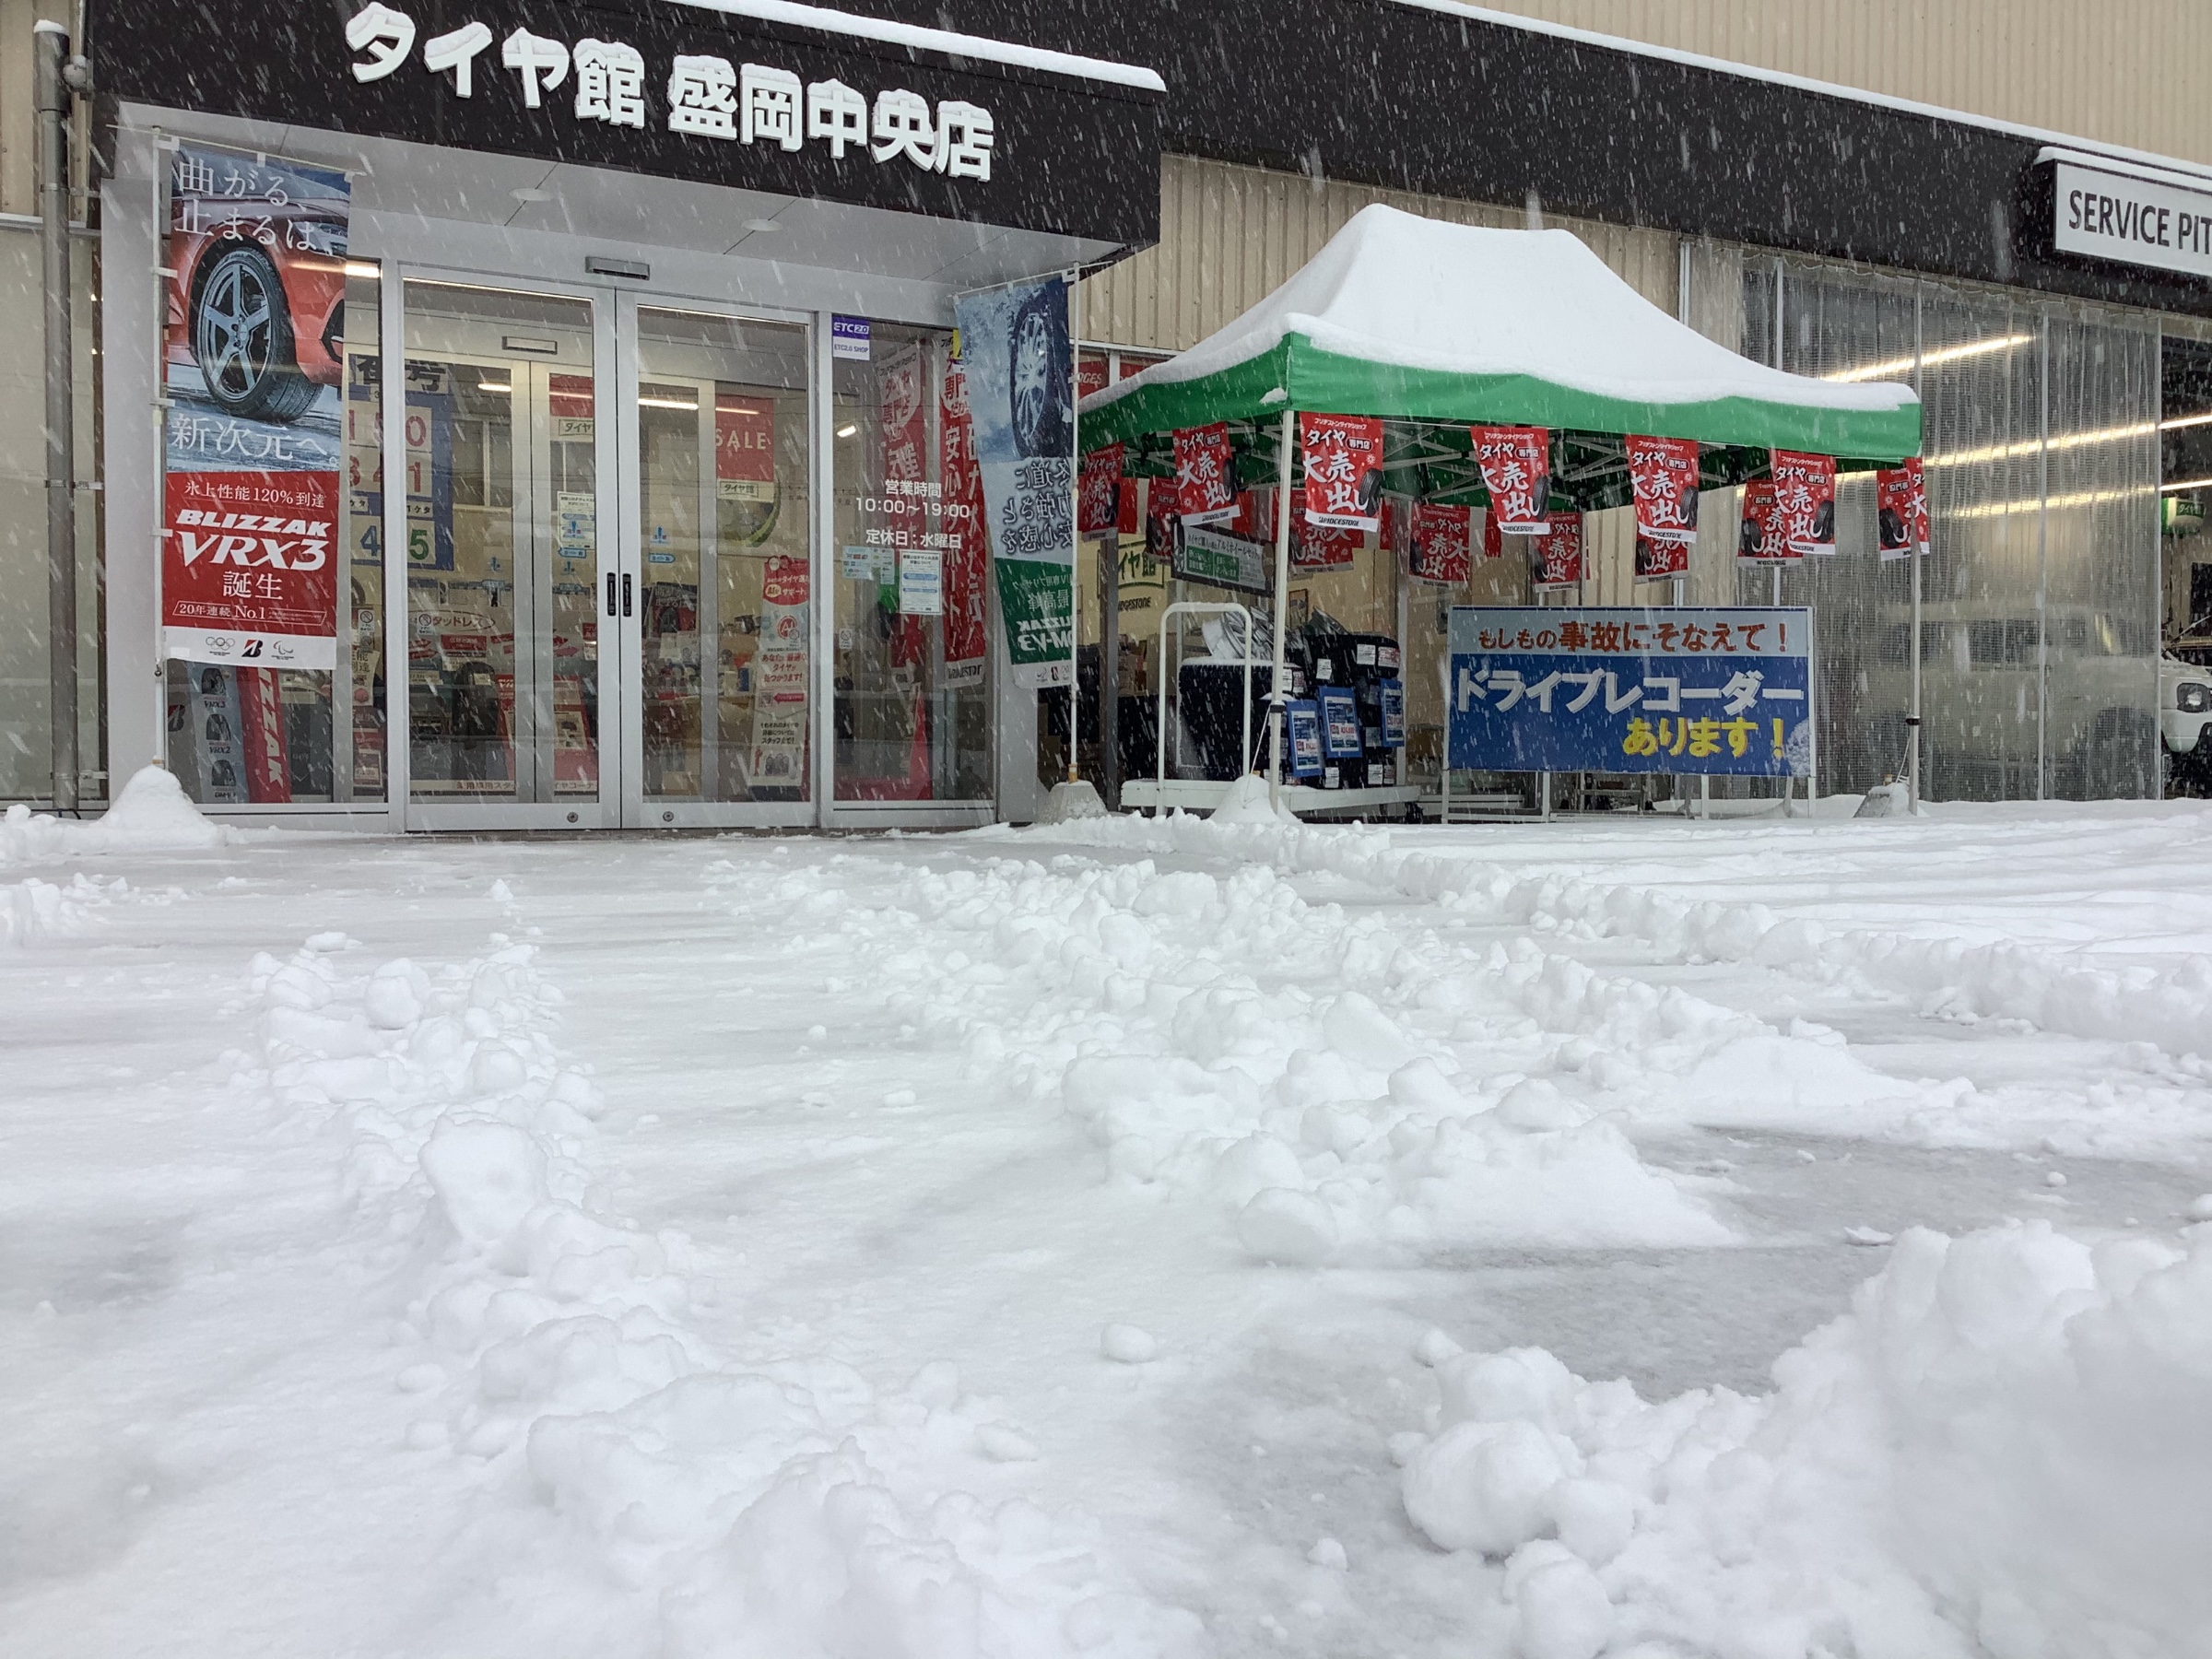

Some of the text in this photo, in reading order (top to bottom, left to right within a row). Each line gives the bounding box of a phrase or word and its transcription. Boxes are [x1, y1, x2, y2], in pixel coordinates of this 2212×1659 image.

[347, 6, 994, 182] タイヤ館 盛岡中央店
[2068, 190, 2212, 254] SERVICE PIT
[853, 345, 869, 354] SHOP
[565, 421, 594, 434] タイヤ
[1306, 429, 1347, 447] タイヤ
[716, 428, 768, 450] SALE
[1181, 431, 1205, 454] タイヤ
[1479, 442, 1515, 460] タイヤ
[1631, 451, 1666, 467] タイヤ
[1775, 466, 1806, 482] タイヤ
[885, 479, 942, 499] 営業時間
[176, 509, 332, 537] BLIZZAK
[176, 531, 330, 571] VRX3
[408, 529, 429, 560] 5
[1118, 550, 1157, 580] イヤ館
[222, 571, 284, 600] 誕生
[179, 603, 230, 617] 20年連続
[234, 605, 265, 619] No.1
[257, 666, 284, 787] IZZAK
